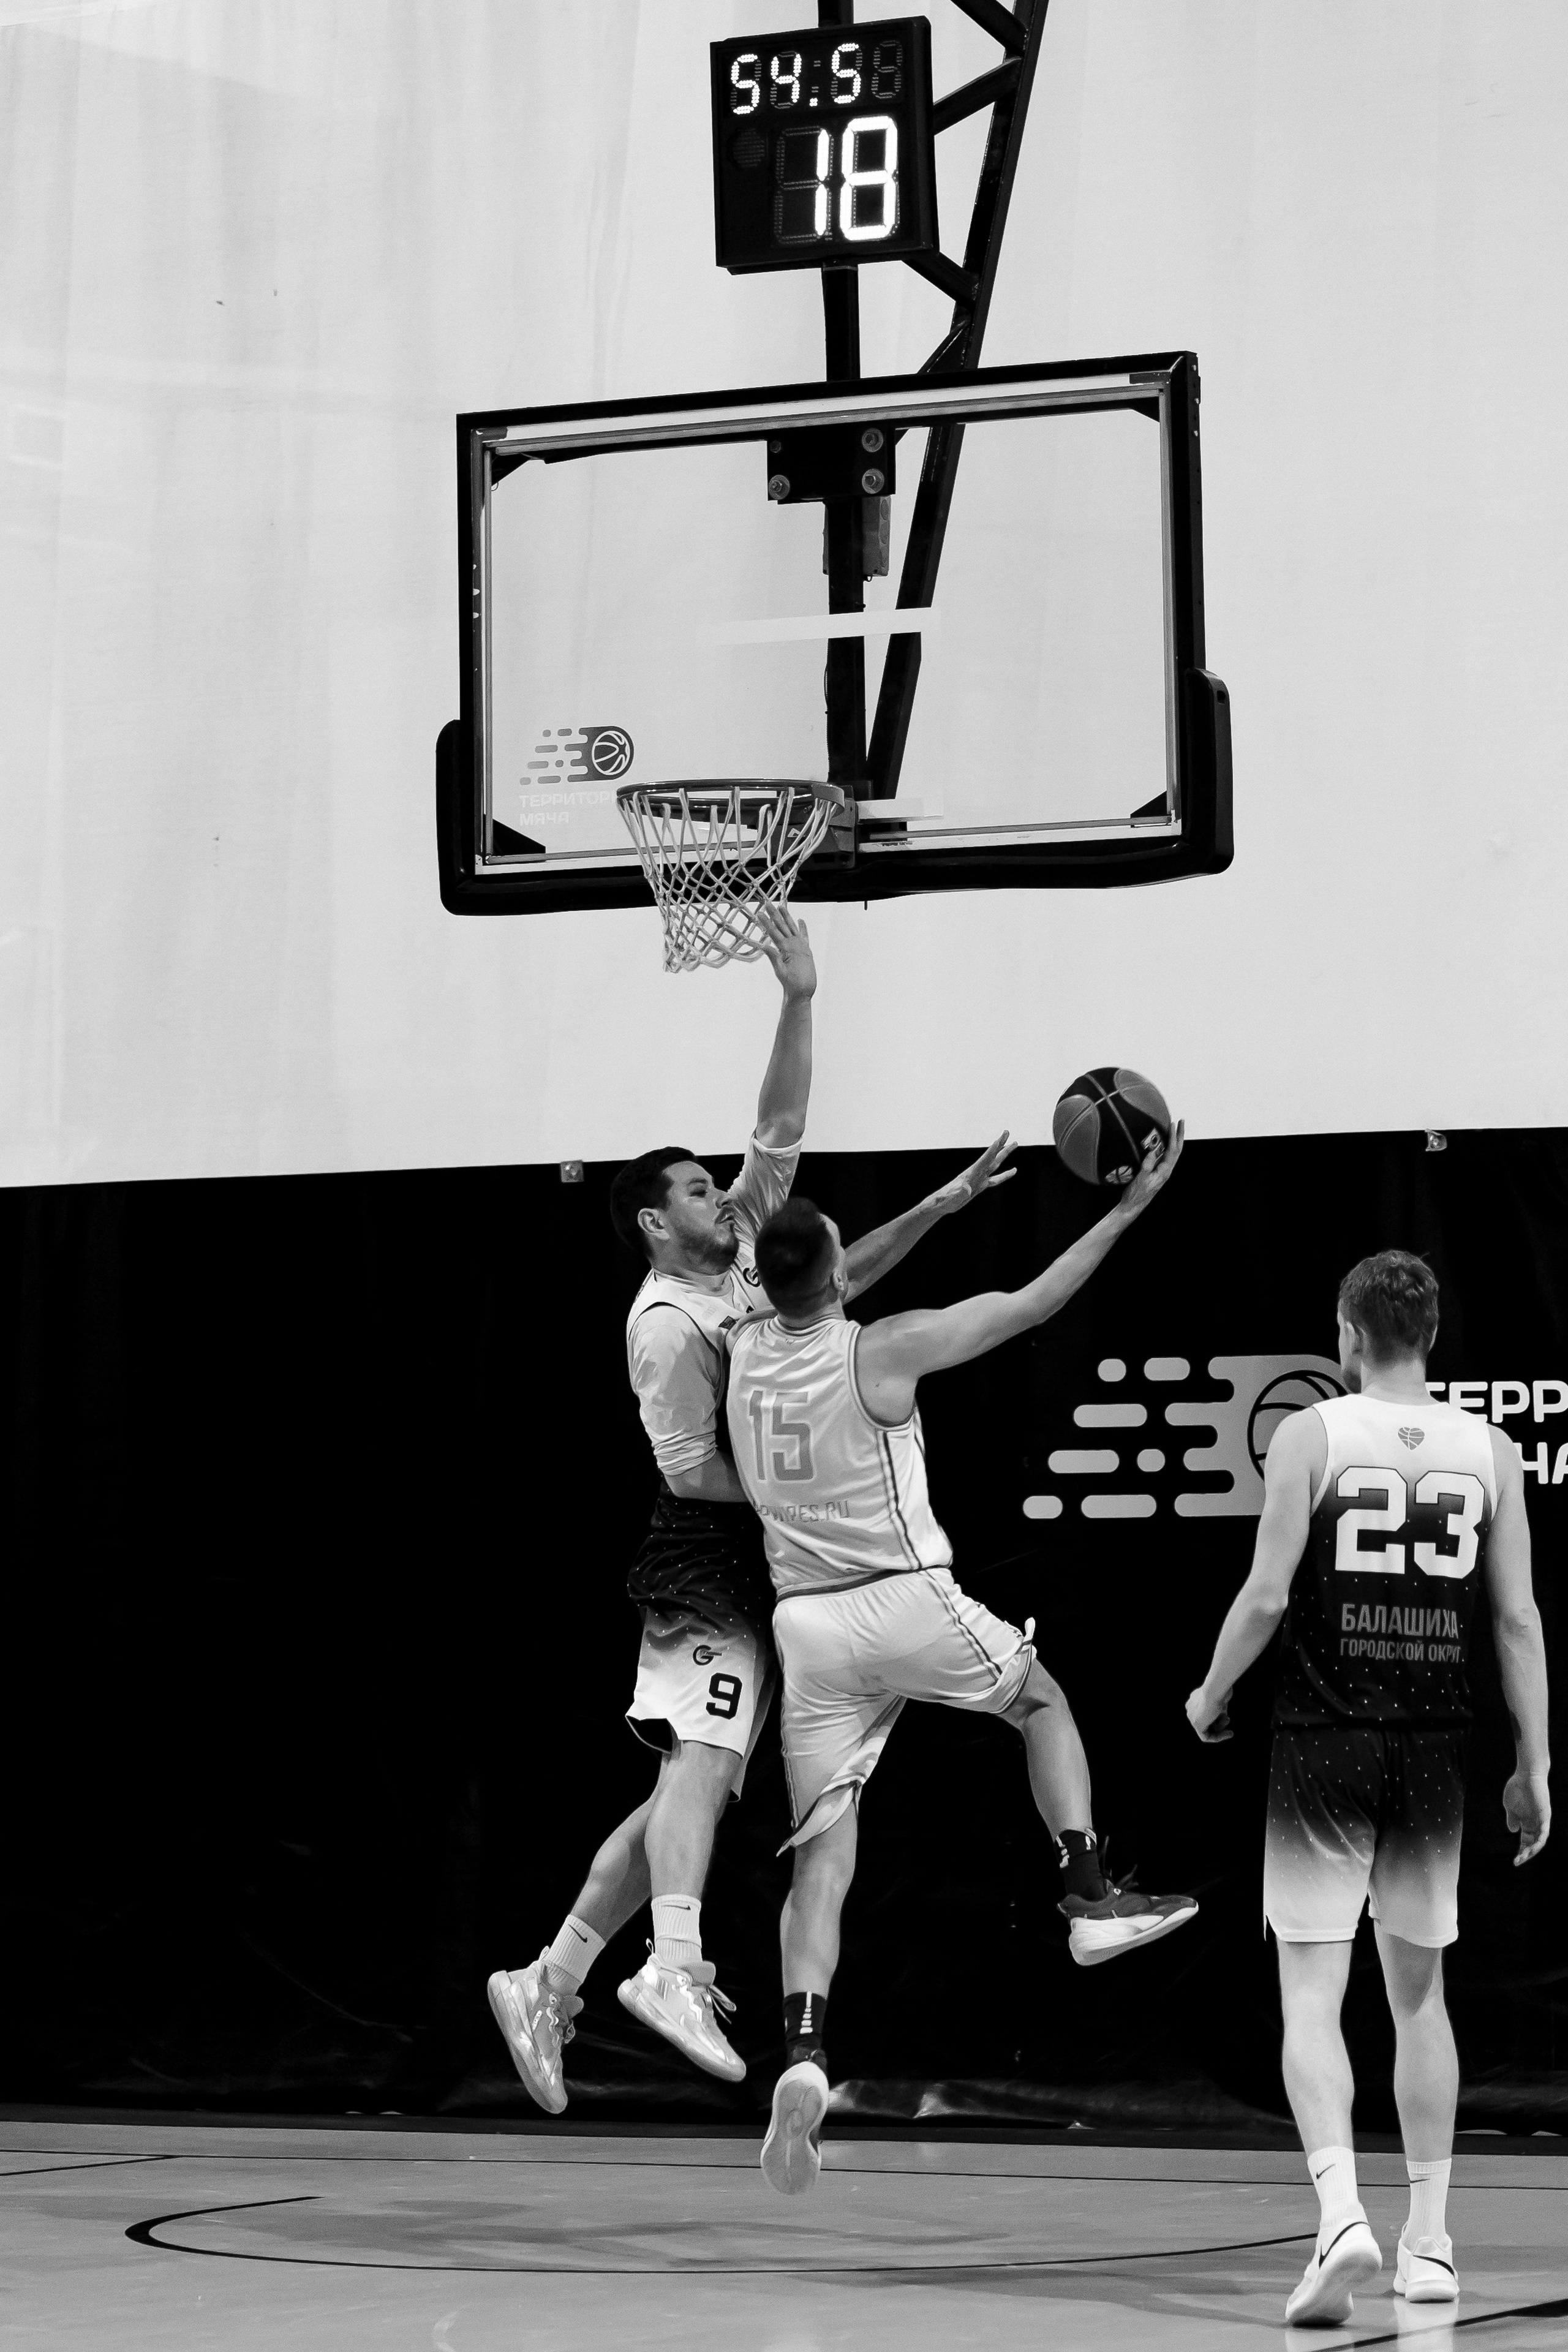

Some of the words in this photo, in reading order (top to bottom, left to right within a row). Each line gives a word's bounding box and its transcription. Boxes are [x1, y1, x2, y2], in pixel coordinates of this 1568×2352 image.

[731, 42, 861, 115] 54.5
[814, 116, 898, 241] 18
[749, 1390, 814, 1480] 15
[1335, 1466, 1485, 1579] 23
[1340, 1638, 1425, 1661] ГОРОДСКОЙ
[1341, 1603, 1459, 1638] БАЛАШИХА
[706, 1672, 742, 1720] 9
